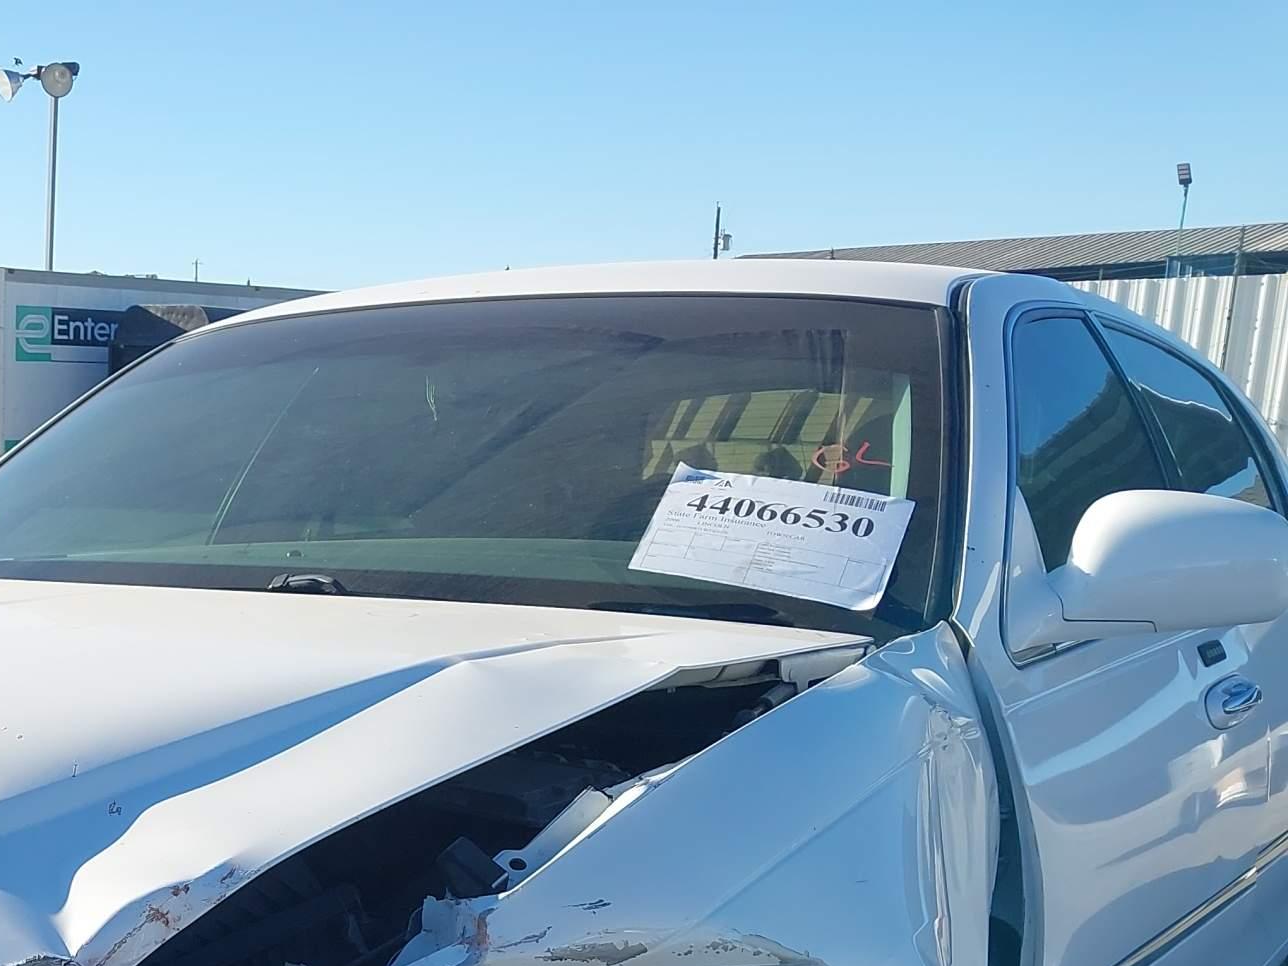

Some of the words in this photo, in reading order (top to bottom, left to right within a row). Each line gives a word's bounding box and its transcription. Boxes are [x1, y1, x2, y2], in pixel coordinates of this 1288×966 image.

[667, 509, 691, 519] State
[693, 512, 719, 521] Farm
[721, 515, 767, 528] Insurance
[686, 493, 875, 538] 44066530
